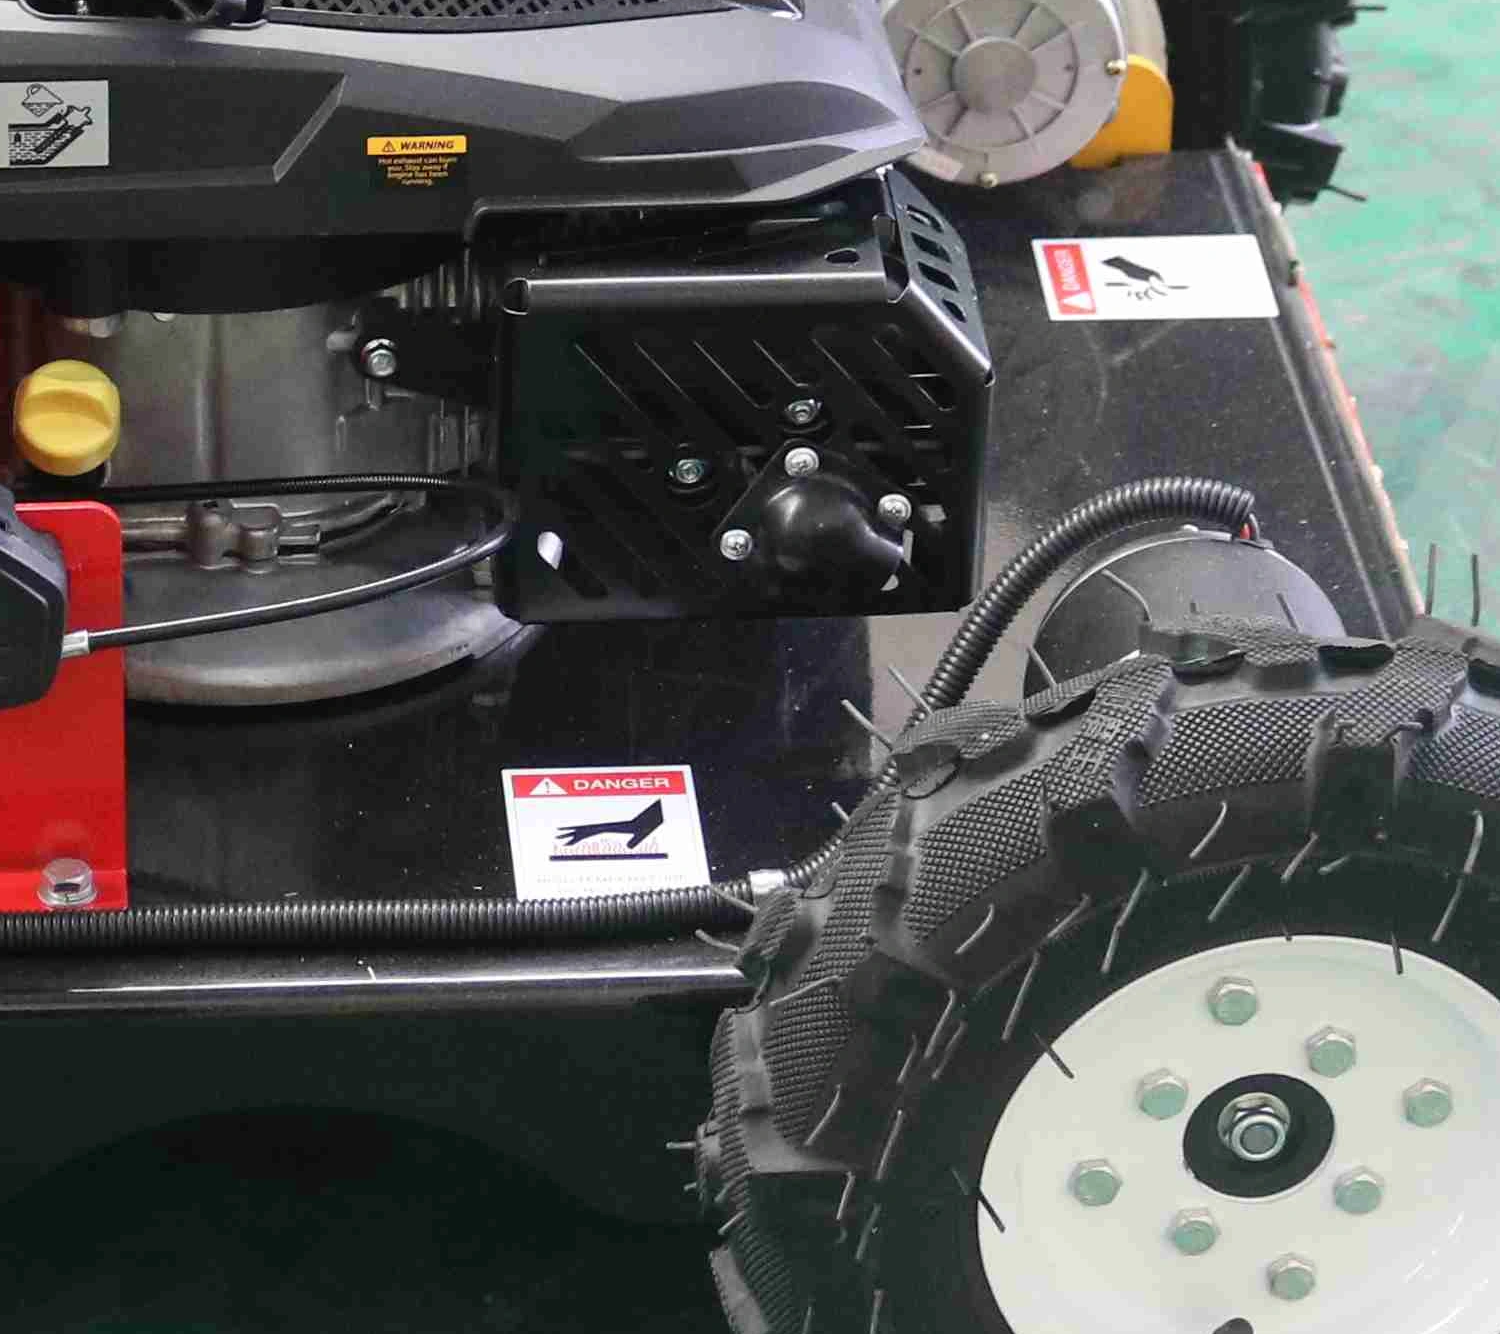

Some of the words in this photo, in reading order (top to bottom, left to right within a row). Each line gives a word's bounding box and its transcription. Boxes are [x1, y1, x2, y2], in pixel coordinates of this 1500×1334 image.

[400, 140, 456, 151] WARNING
[1053, 250, 1082, 291] DANGER
[573, 777, 671, 791] DANGER
